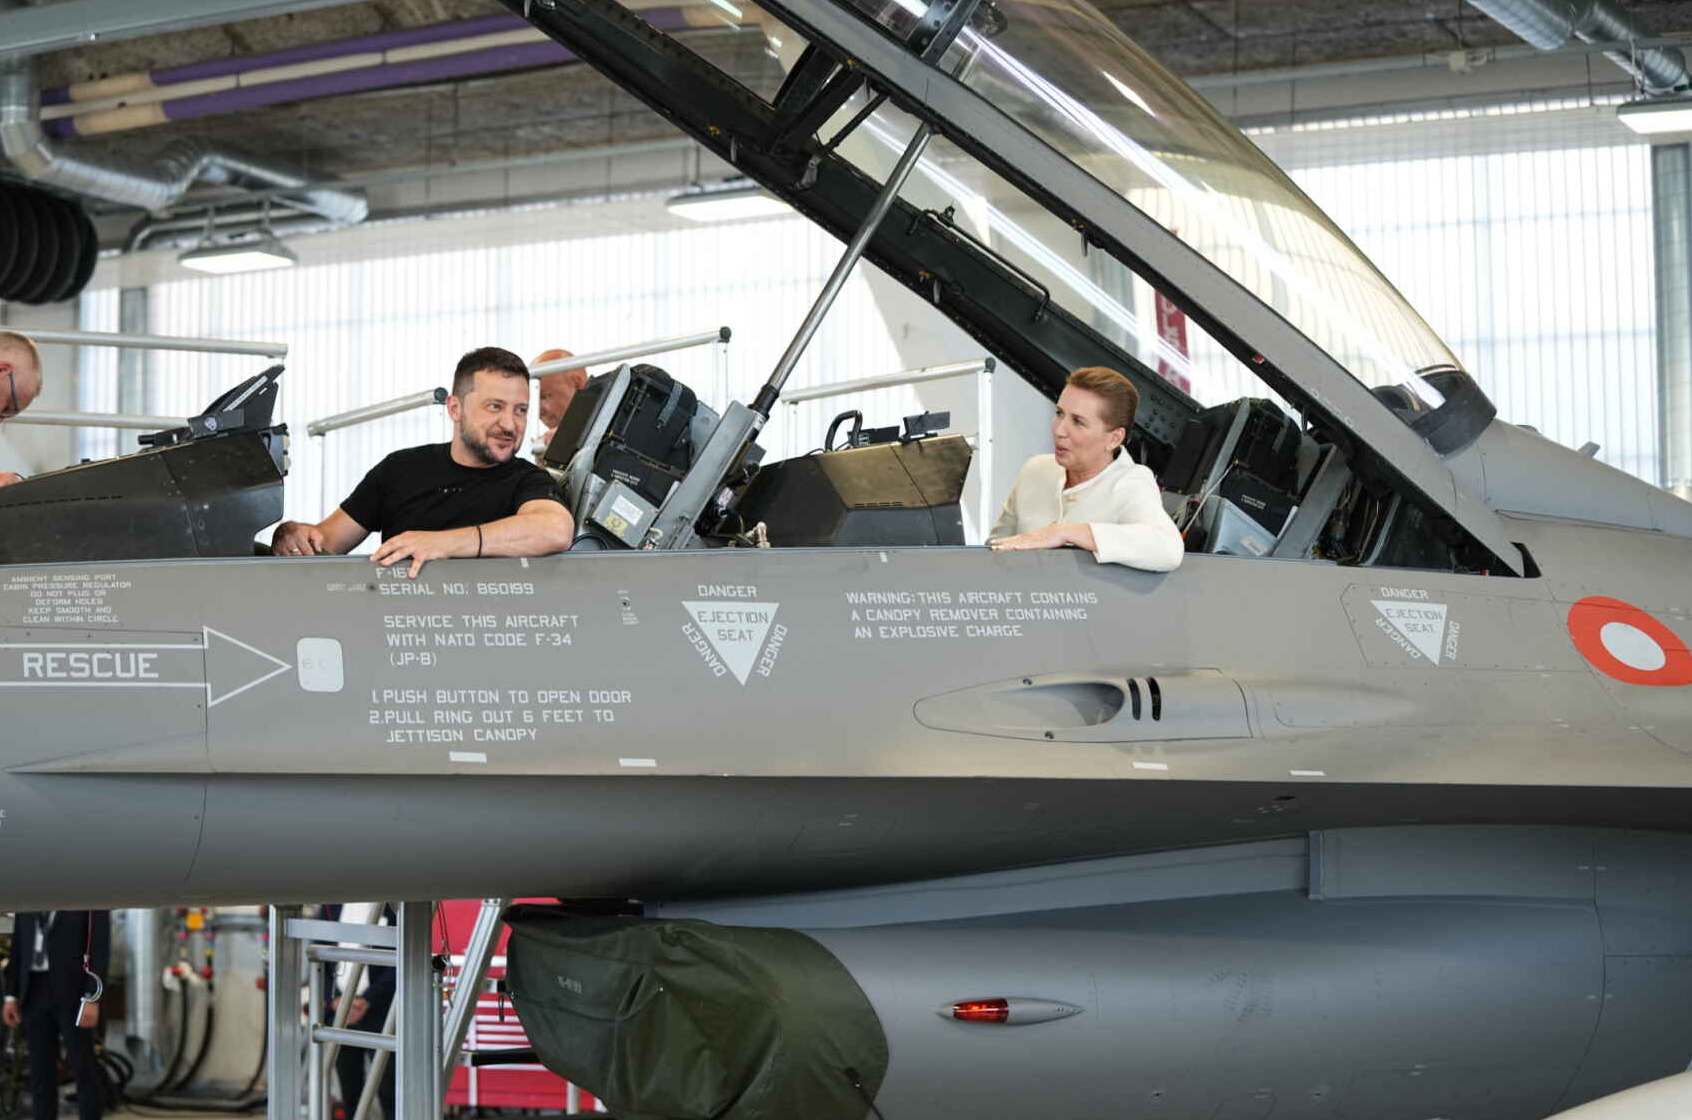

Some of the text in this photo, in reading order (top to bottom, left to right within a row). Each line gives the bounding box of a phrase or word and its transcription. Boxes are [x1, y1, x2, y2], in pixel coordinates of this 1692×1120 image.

[32, 582, 79, 590] PRESSURE
[82, 581, 132, 589] REGULATOR
[379, 582, 435, 595] SERIAL
[443, 582, 469, 595] NO.
[477, 582, 535, 595] 860199
[697, 584, 757, 598] DANGER
[30, 590, 43, 598] DO
[67, 589, 91, 597] PLUG
[958, 591, 1022, 604] AIRCRAFT
[1030, 591, 1098, 604] CONTAINS
[1380, 587, 1429, 600] DANGER
[35, 598, 72, 606] DEFORM
[55, 605, 92, 614] SMOOTH
[851, 608, 1088, 621] A CANOPY REMOVER CONTAINING
[1386, 608, 1444, 620] EJECTION
[54, 614, 84, 622] WITHIN
[87, 614, 119, 622] CIRCLE
[384, 614, 579, 628] SERVICE THIS AIRCRAFT
[697, 611, 769, 623] EJECTION
[855, 624, 1024, 638] AN EXPLOSIVE CHARGE
[1405, 622, 1435, 634] SEAT
[386, 633, 427, 646] WITH
[435, 633, 475, 646] NATO
[484, 633, 528, 646] CODE
[716, 629, 754, 641] SEAT
[1375, 617, 1422, 659] DANGER
[681, 622, 727, 677] DANGER
[756, 623, 788, 677] DANGER
[22, 652, 159, 678] RESCUE
[436, 689, 500, 704] BUTTON
[508, 689, 529, 704] TO
[537, 690, 582, 704] OPEN
[588, 690, 632, 704] DOOR
[433, 710, 473, 724] RING
[482, 710, 513, 723] OUT
[522, 710, 534, 723] 6
[542, 709, 584, 723] FEET
[592, 709, 615, 722] TO
[386, 728, 537, 743] JETTISON CANOPY
